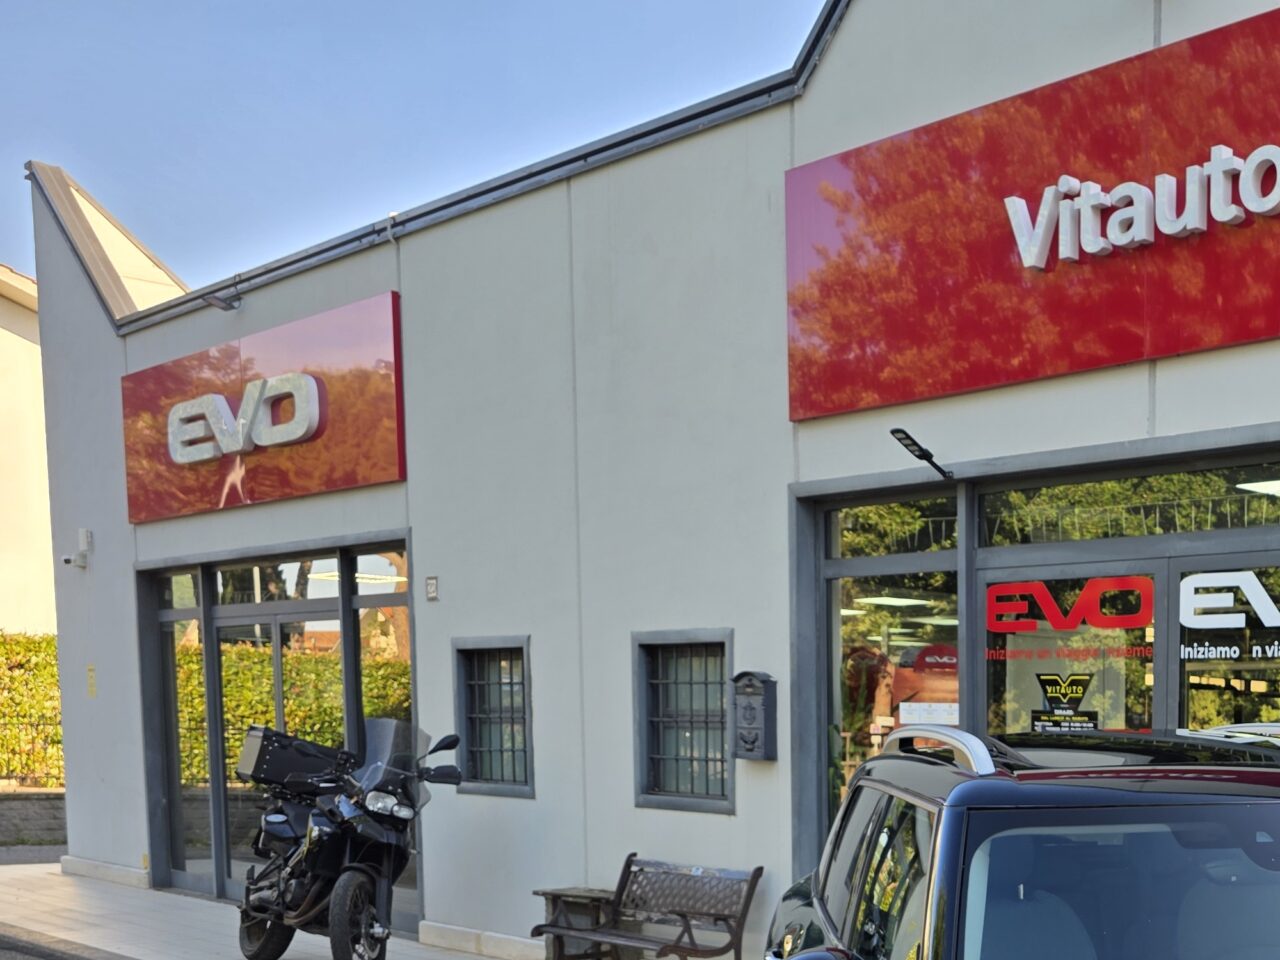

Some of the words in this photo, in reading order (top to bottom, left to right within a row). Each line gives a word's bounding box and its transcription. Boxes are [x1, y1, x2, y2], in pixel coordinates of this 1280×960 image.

[168, 372, 320, 465] EVO
[986, 575, 1155, 633] EVO
[1180, 641, 1240, 659] Iniziamo
[1045, 685, 1084, 694] VITAUTO
